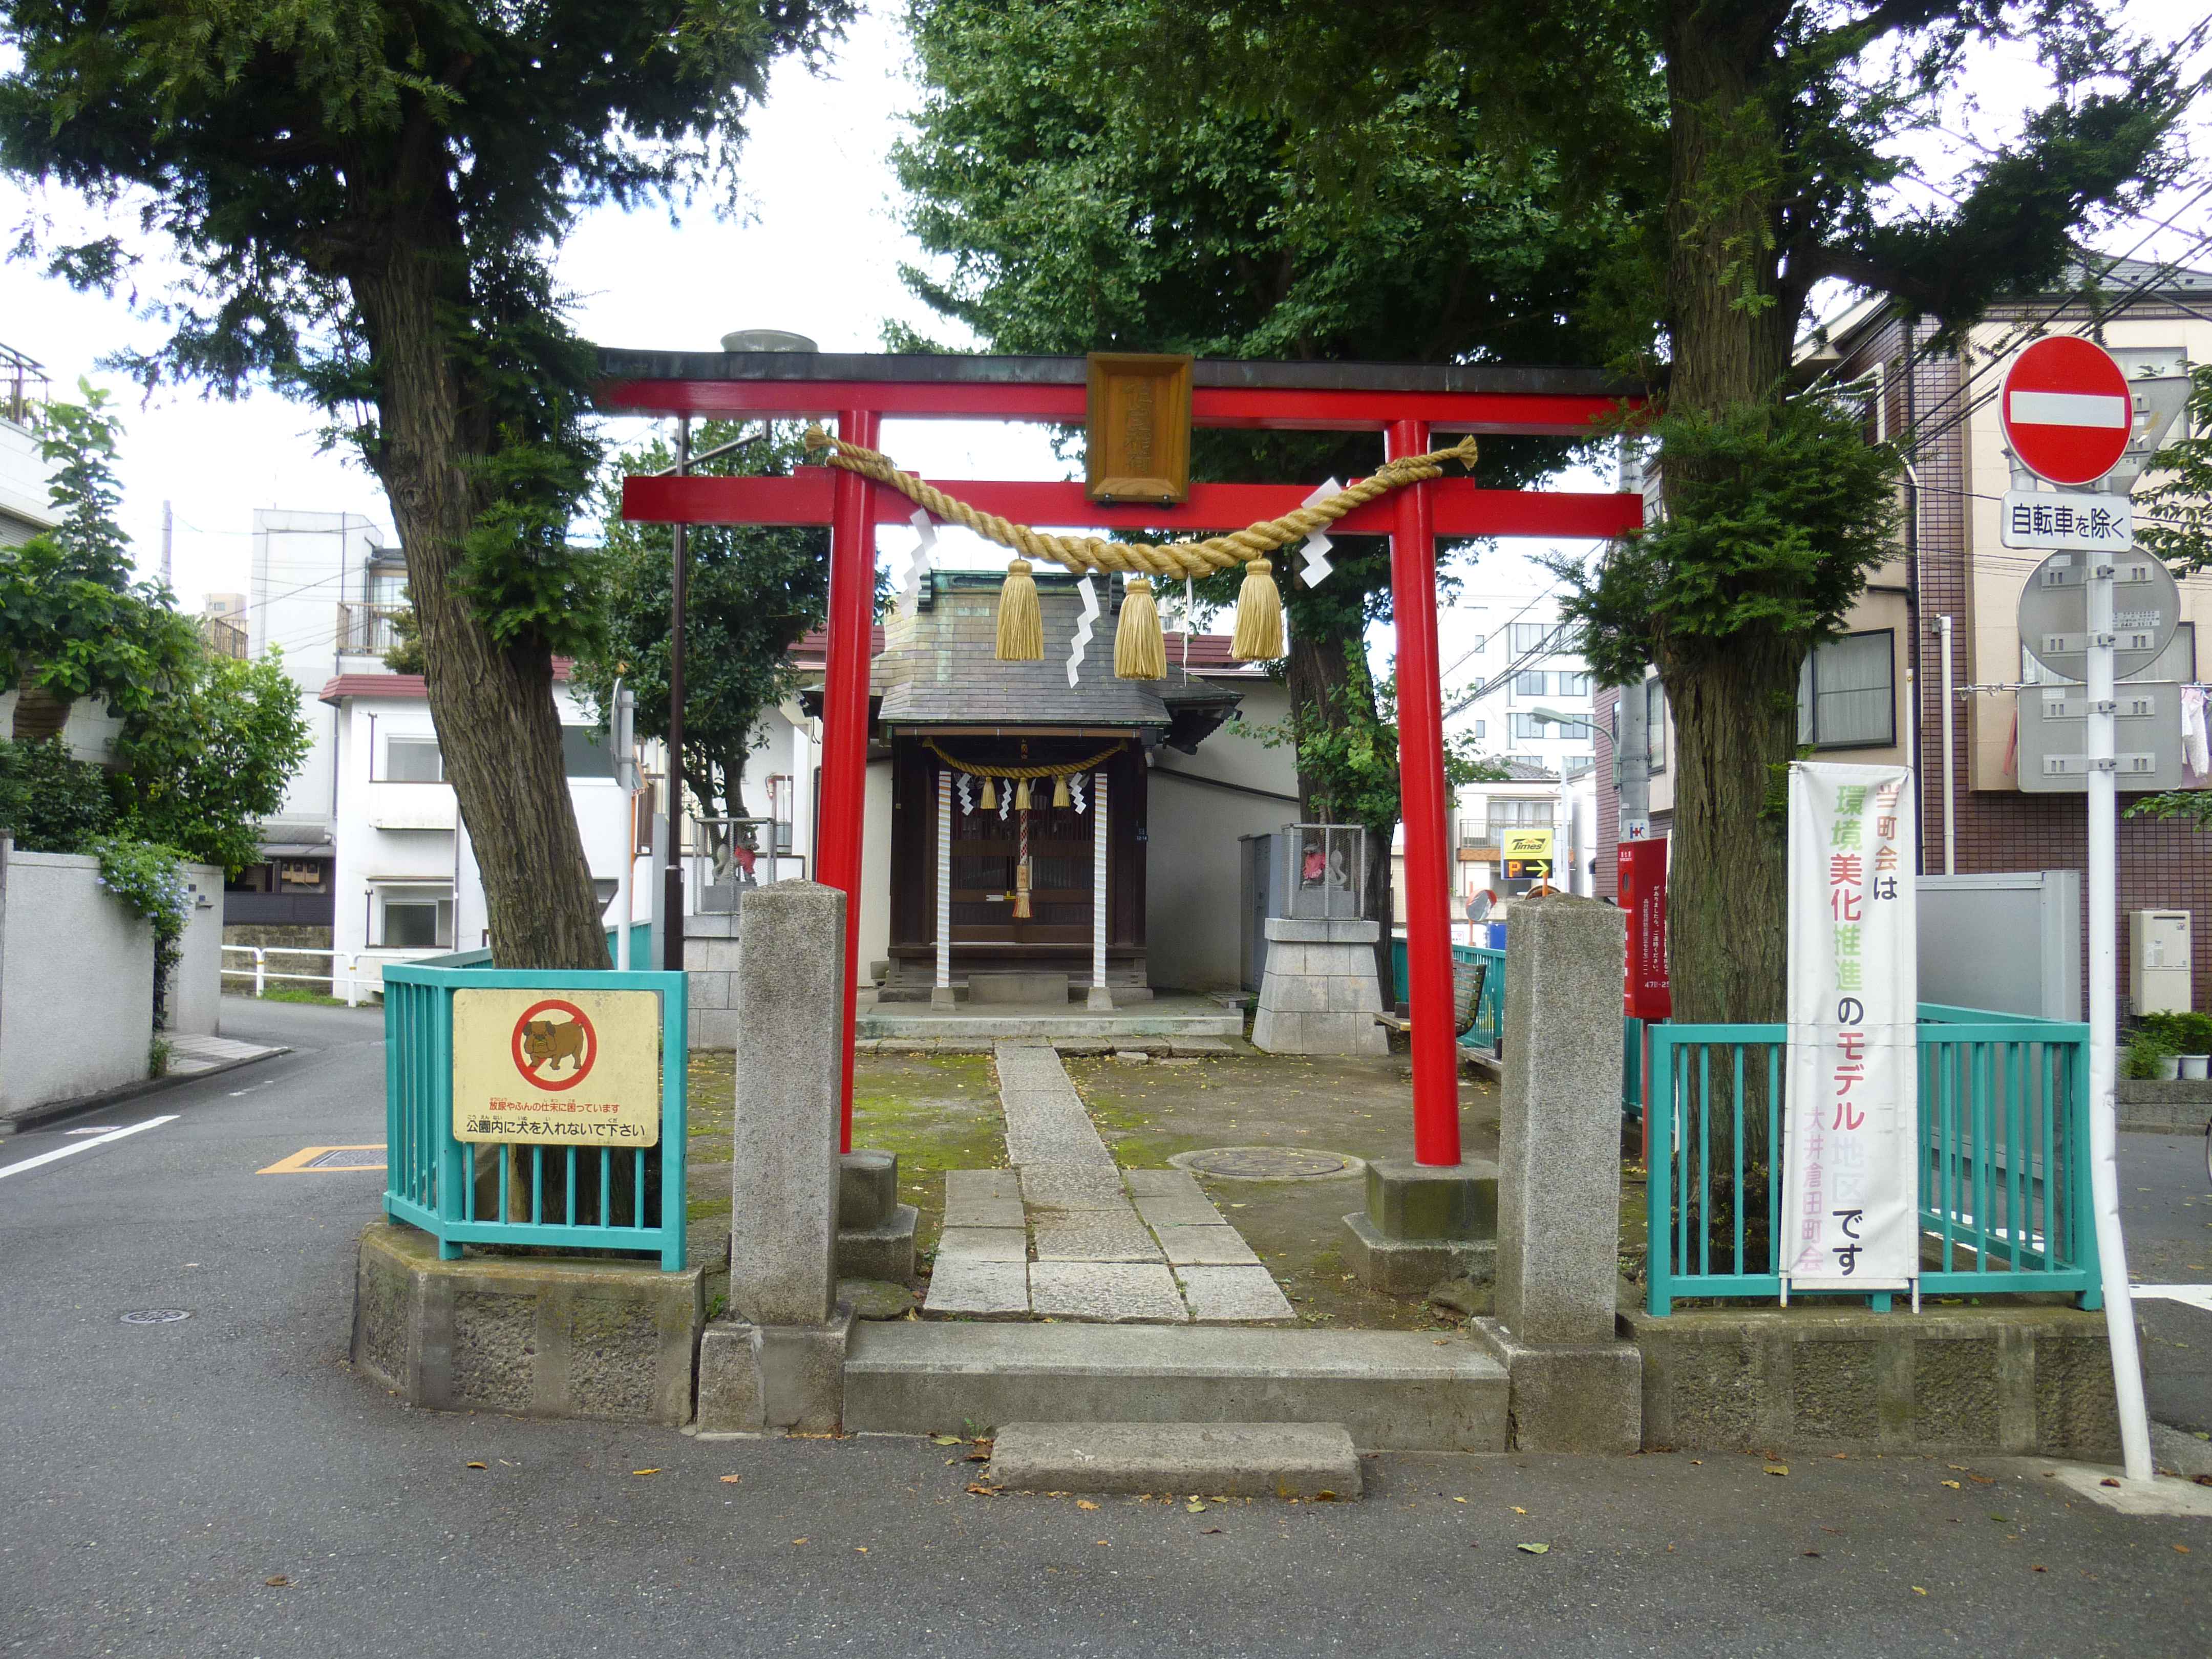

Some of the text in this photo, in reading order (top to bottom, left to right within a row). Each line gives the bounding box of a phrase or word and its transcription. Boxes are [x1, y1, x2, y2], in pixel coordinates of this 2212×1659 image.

[2012, 503, 2124, 538] 自転車を除く
[1512, 838, 1545, 850] Times
[1874, 784, 1900, 900] 当町会は
[1508, 861, 1520, 877] P
[490, 1101, 620, 1113] 放尿やふんの仕末に困っています
[466, 1120, 645, 1137] 公園内に犬を入れないで下さい
